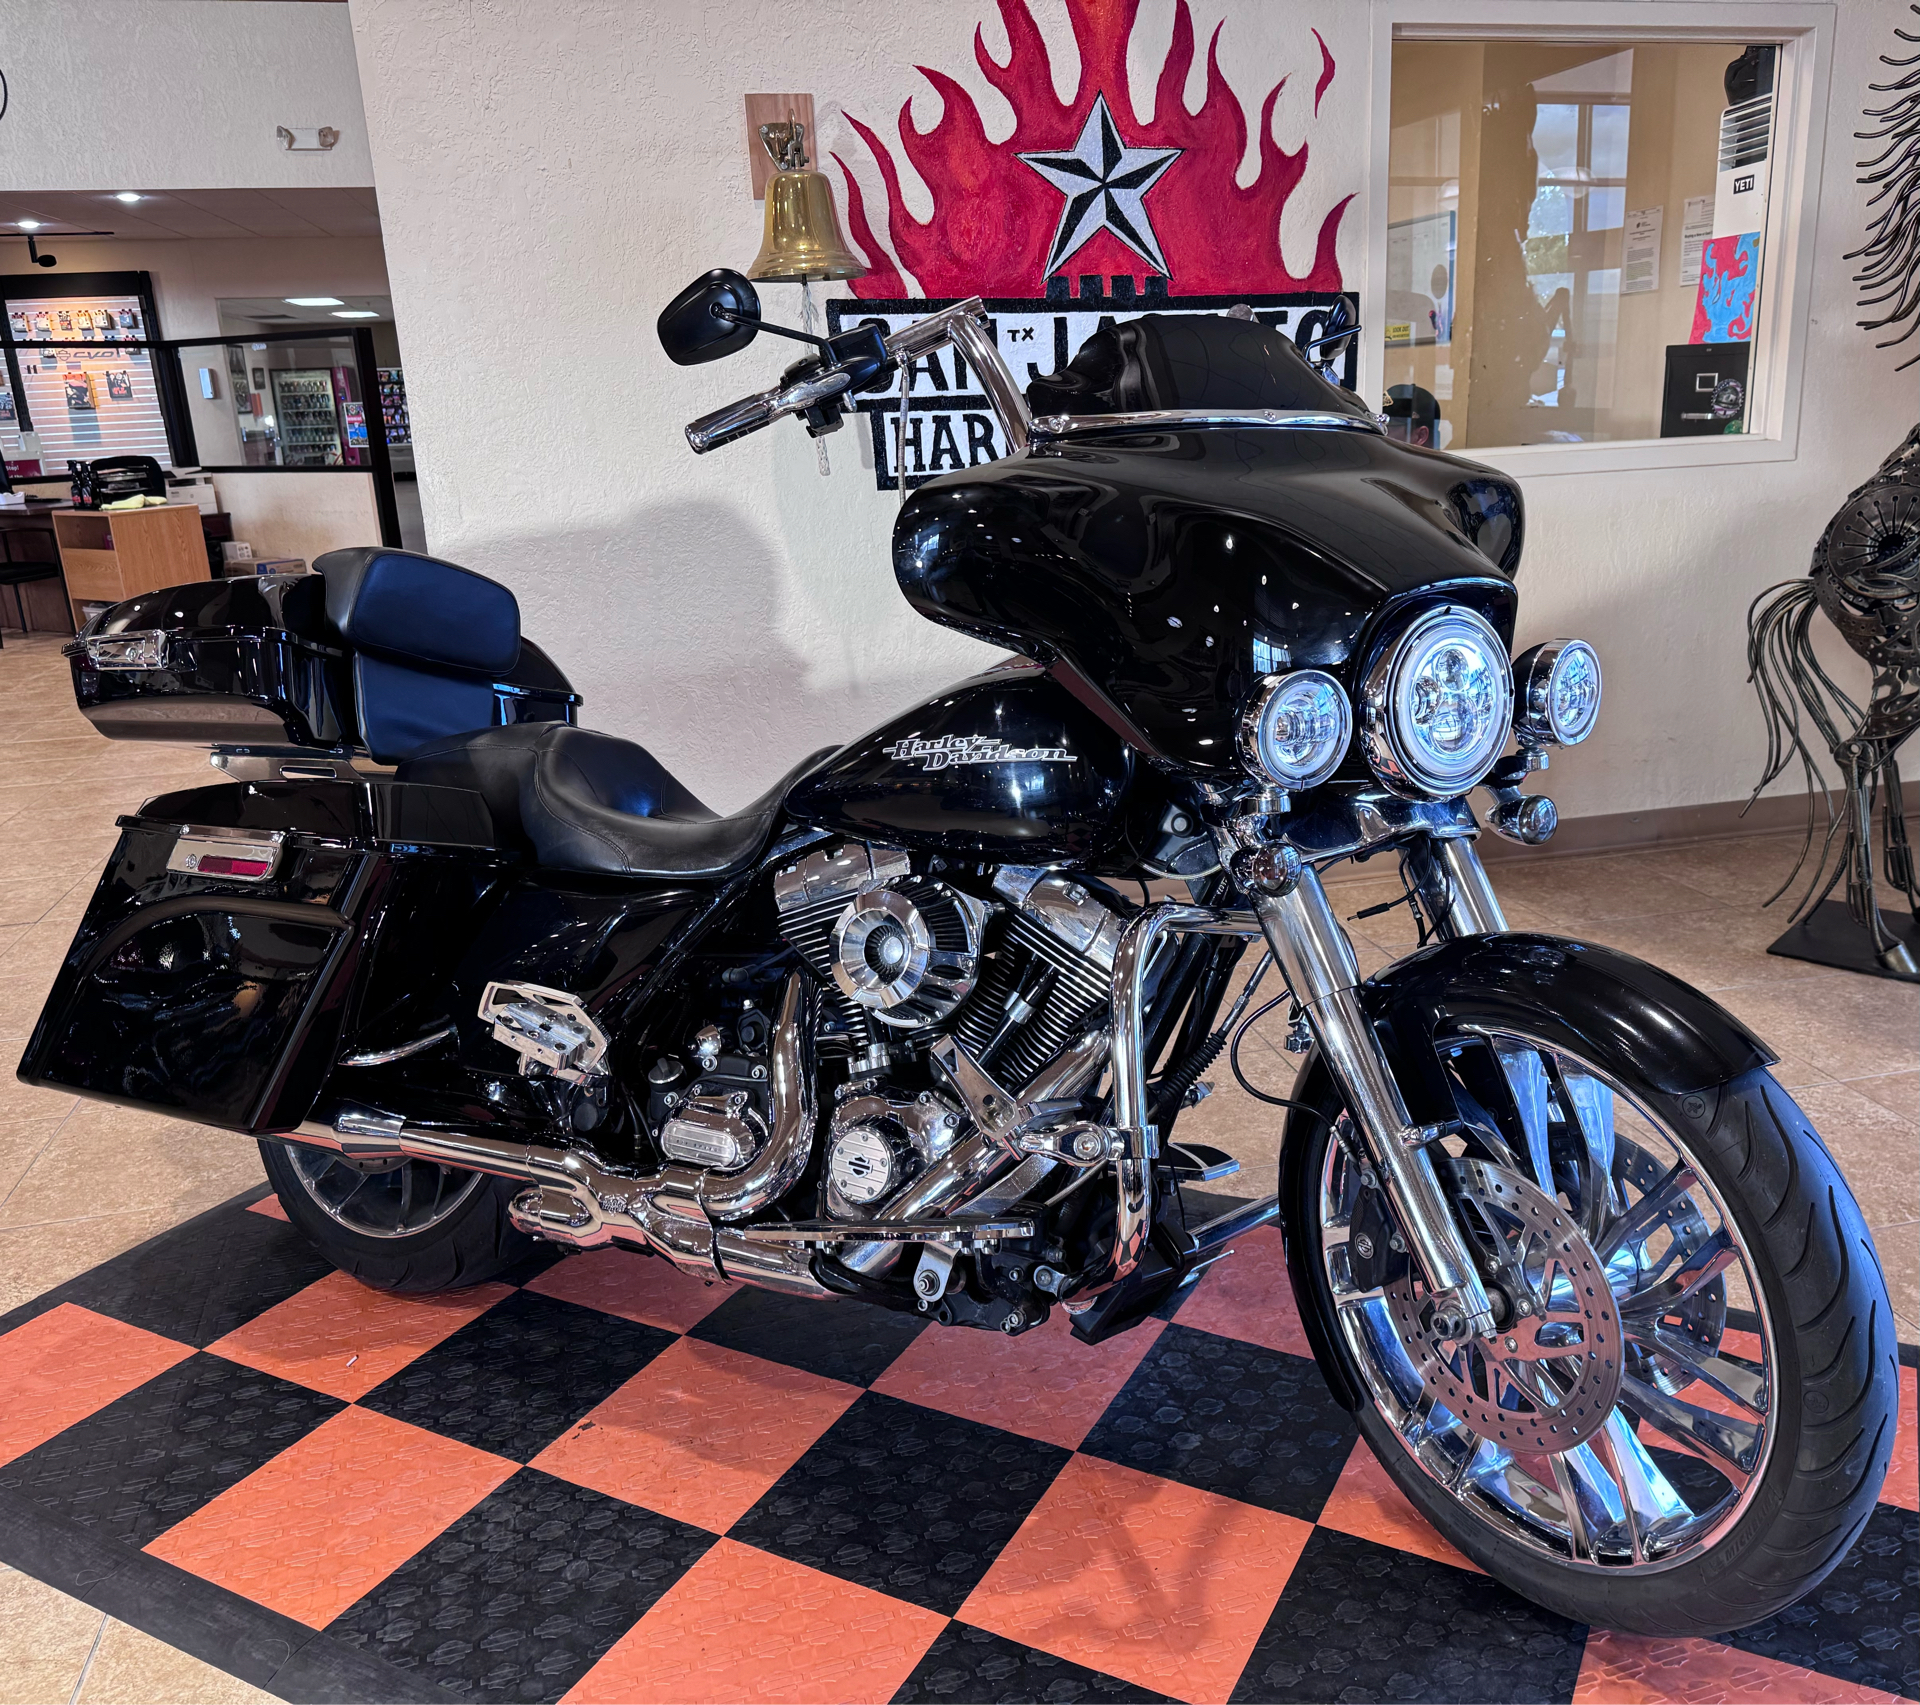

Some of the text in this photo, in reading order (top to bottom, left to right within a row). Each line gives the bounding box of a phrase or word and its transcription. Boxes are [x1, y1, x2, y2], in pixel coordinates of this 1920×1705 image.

[1735, 177, 1753, 192] YETI
[1007, 327, 1034, 342] TX
[73, 350, 114, 360] CVO
[890, 413, 1010, 473] HAR
[883, 734, 1002, 761] Harley
